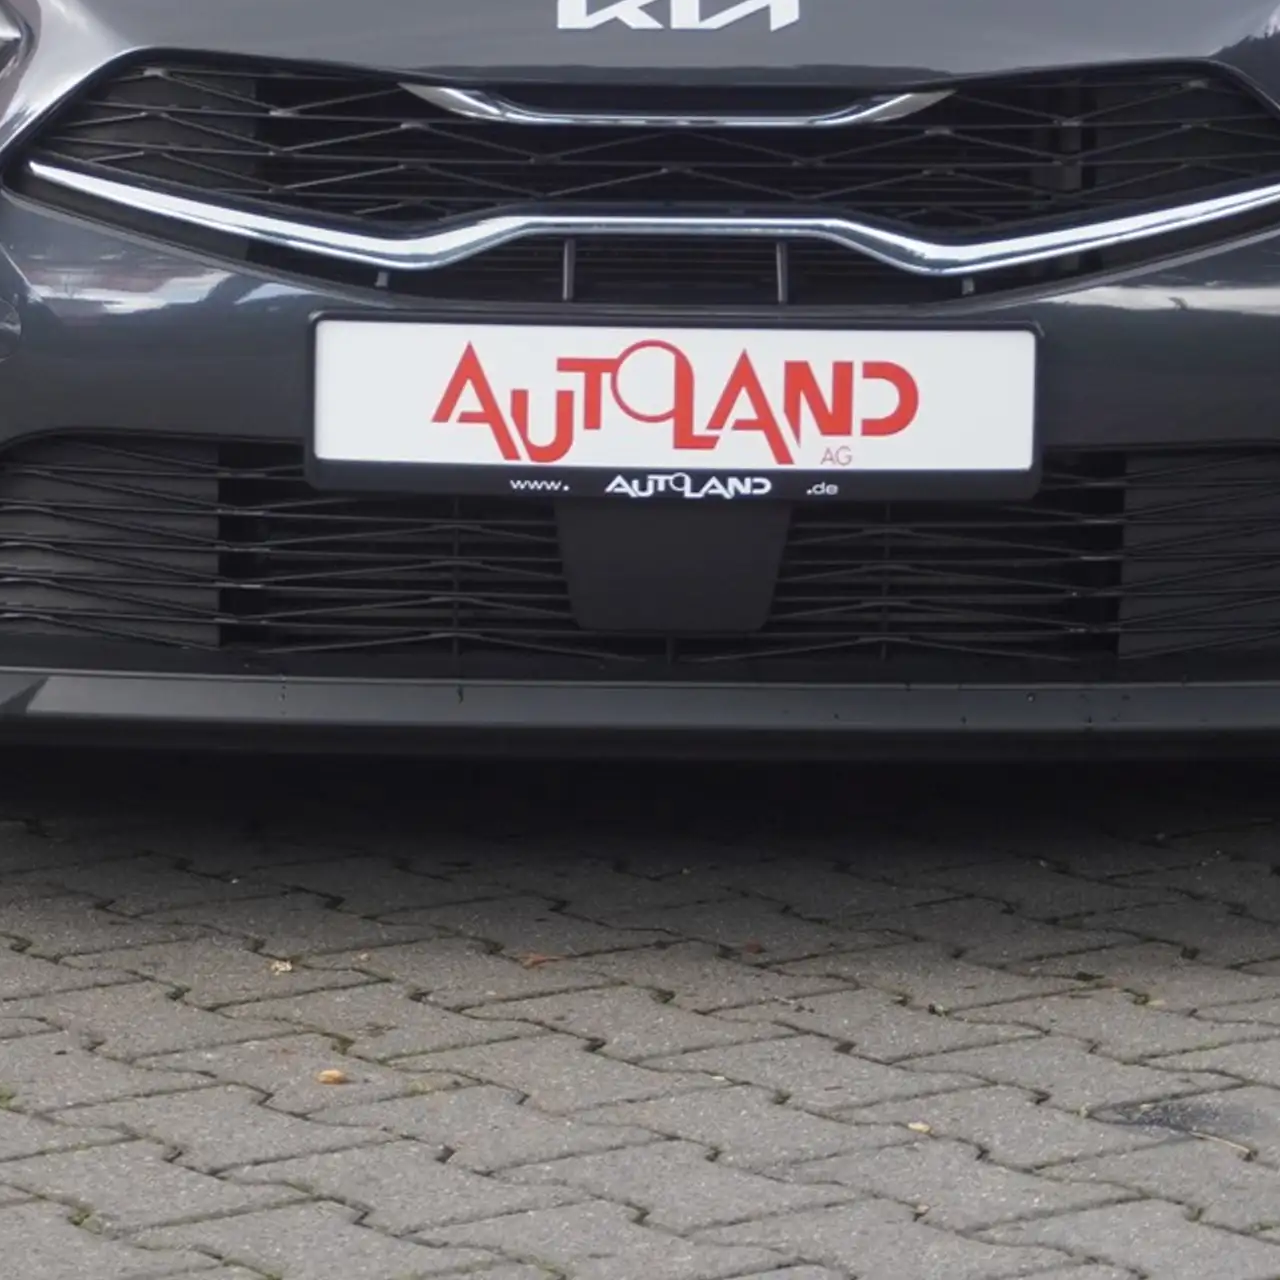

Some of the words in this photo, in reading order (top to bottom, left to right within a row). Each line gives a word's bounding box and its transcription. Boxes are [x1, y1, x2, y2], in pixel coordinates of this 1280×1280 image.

[431, 340, 920, 465] AUTOLAND
[820, 446, 854, 466] AG
[510, 478, 570, 493] www.
[605, 471, 773, 500] AUTOLAND
[806, 480, 840, 496] .de
